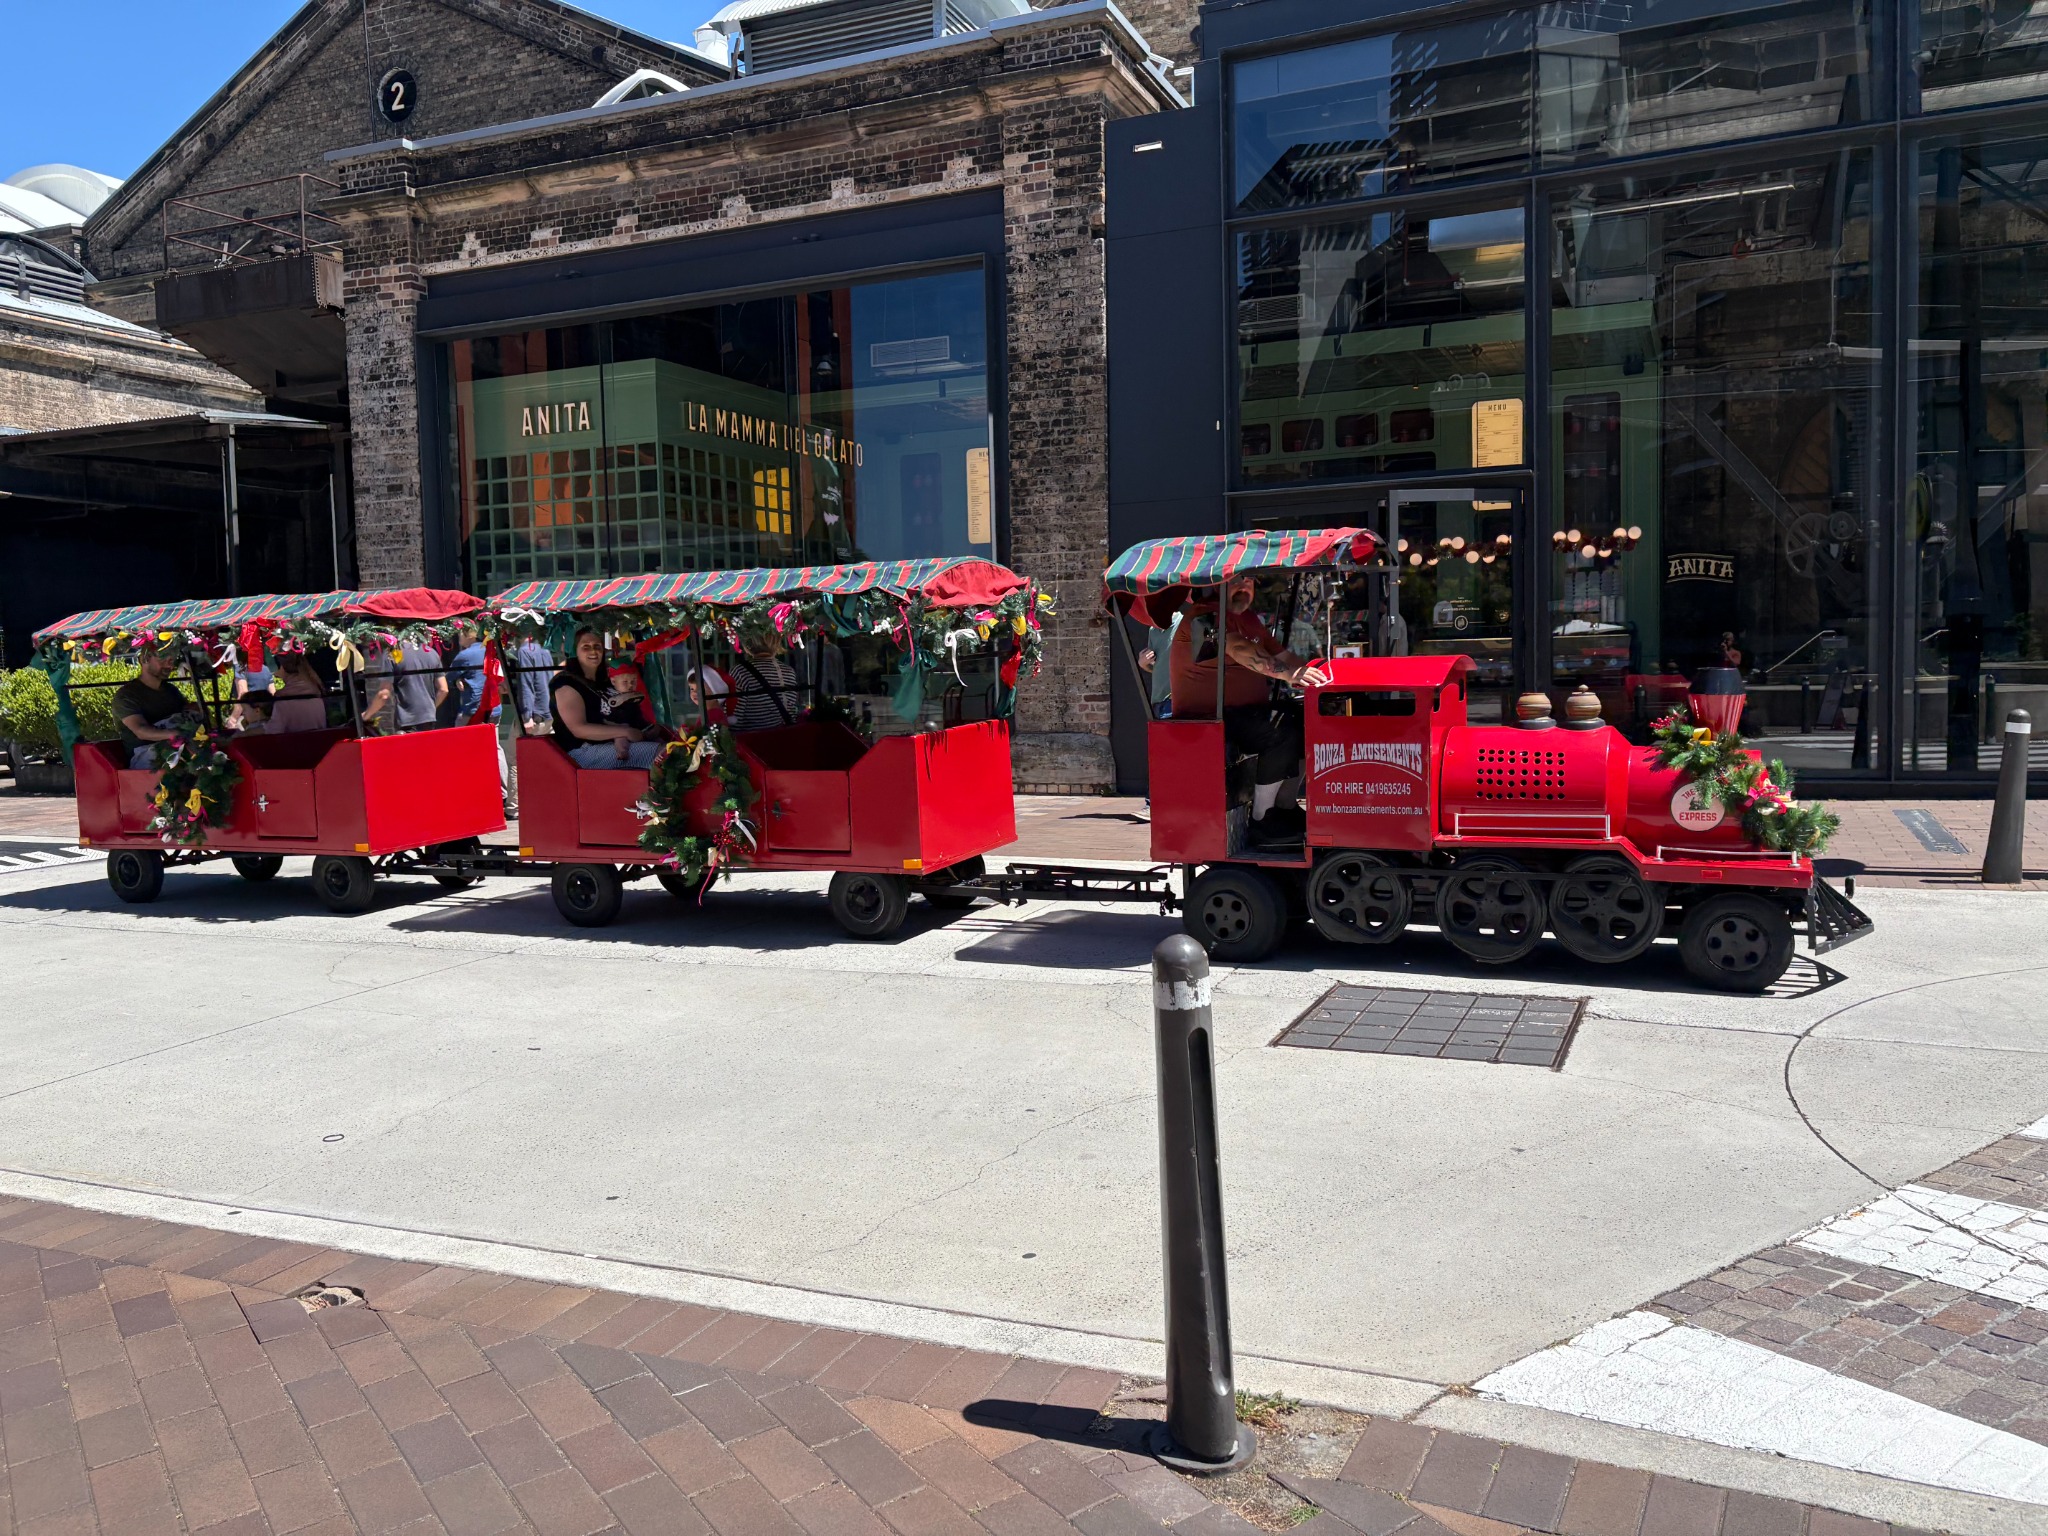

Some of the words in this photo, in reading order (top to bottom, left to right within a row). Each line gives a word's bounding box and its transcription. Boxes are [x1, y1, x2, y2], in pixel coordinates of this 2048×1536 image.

[391, 82, 405, 111] 2
[1488, 403, 1507, 412] MENU
[522, 401, 591, 437] ANITA
[687, 401, 709, 433] LA
[716, 408, 777, 449] MAMMA
[783, 424, 809, 456] DEL
[814, 432, 863, 467] GELATO
[1667, 558, 1735, 578] ANITA
[1314, 743, 1345, 773] BONZA
[1351, 743, 1422, 774] AMUSEMENTS
[1325, 782, 1343, 794] FOR
[1344, 782, 1364, 794] HIRE
[1365, 783, 1412, 795] 0419635245
[1681, 788, 1696, 799] THE
[1315, 803, 1423, 816] www.bonzaamusements.com.au
[1679, 811, 1717, 822] EXPRESS
